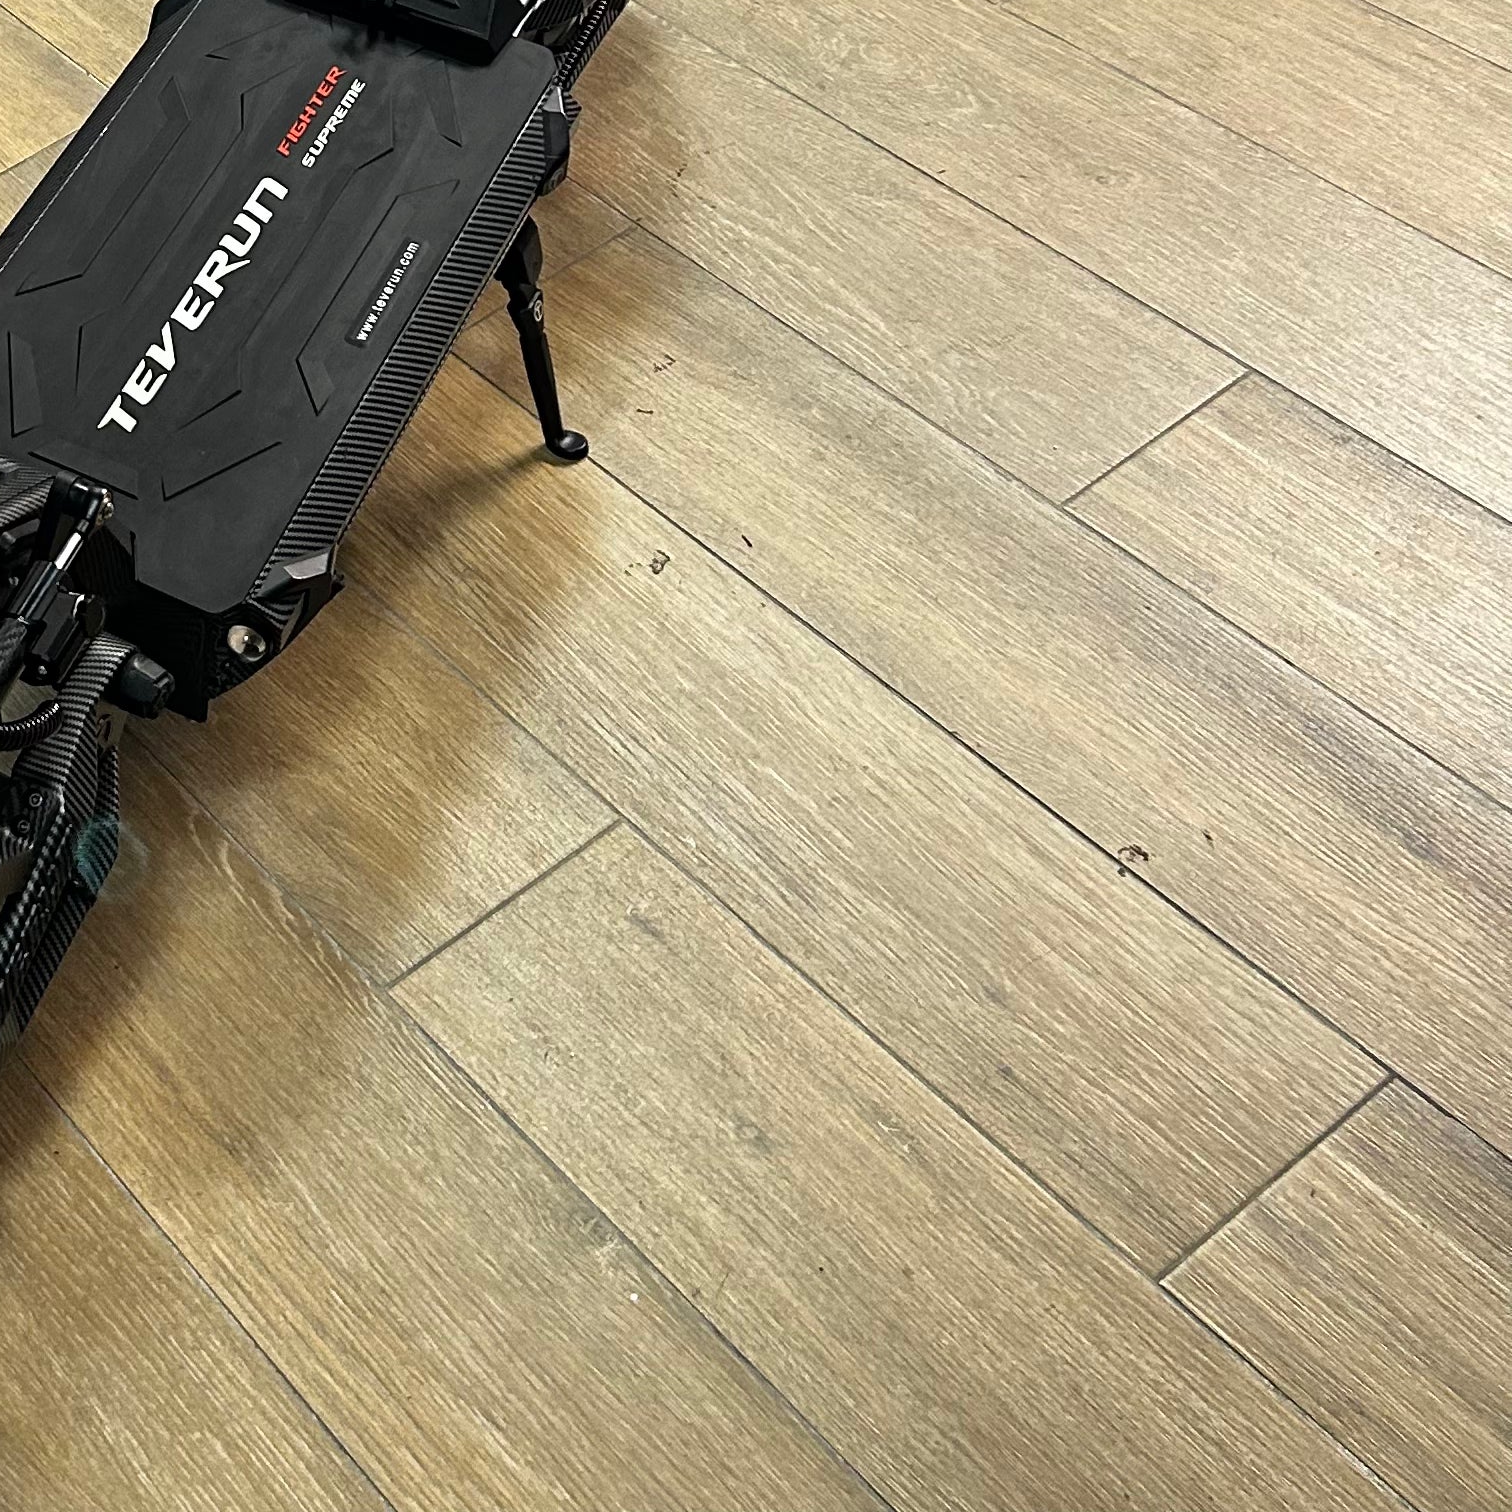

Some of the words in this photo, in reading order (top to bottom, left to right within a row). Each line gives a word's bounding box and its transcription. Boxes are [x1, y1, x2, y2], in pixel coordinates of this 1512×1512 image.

[276, 66, 348, 157] FIGHTER
[301, 78, 366, 168] SUPREME
[97, 177, 288, 433] TEVERUN
